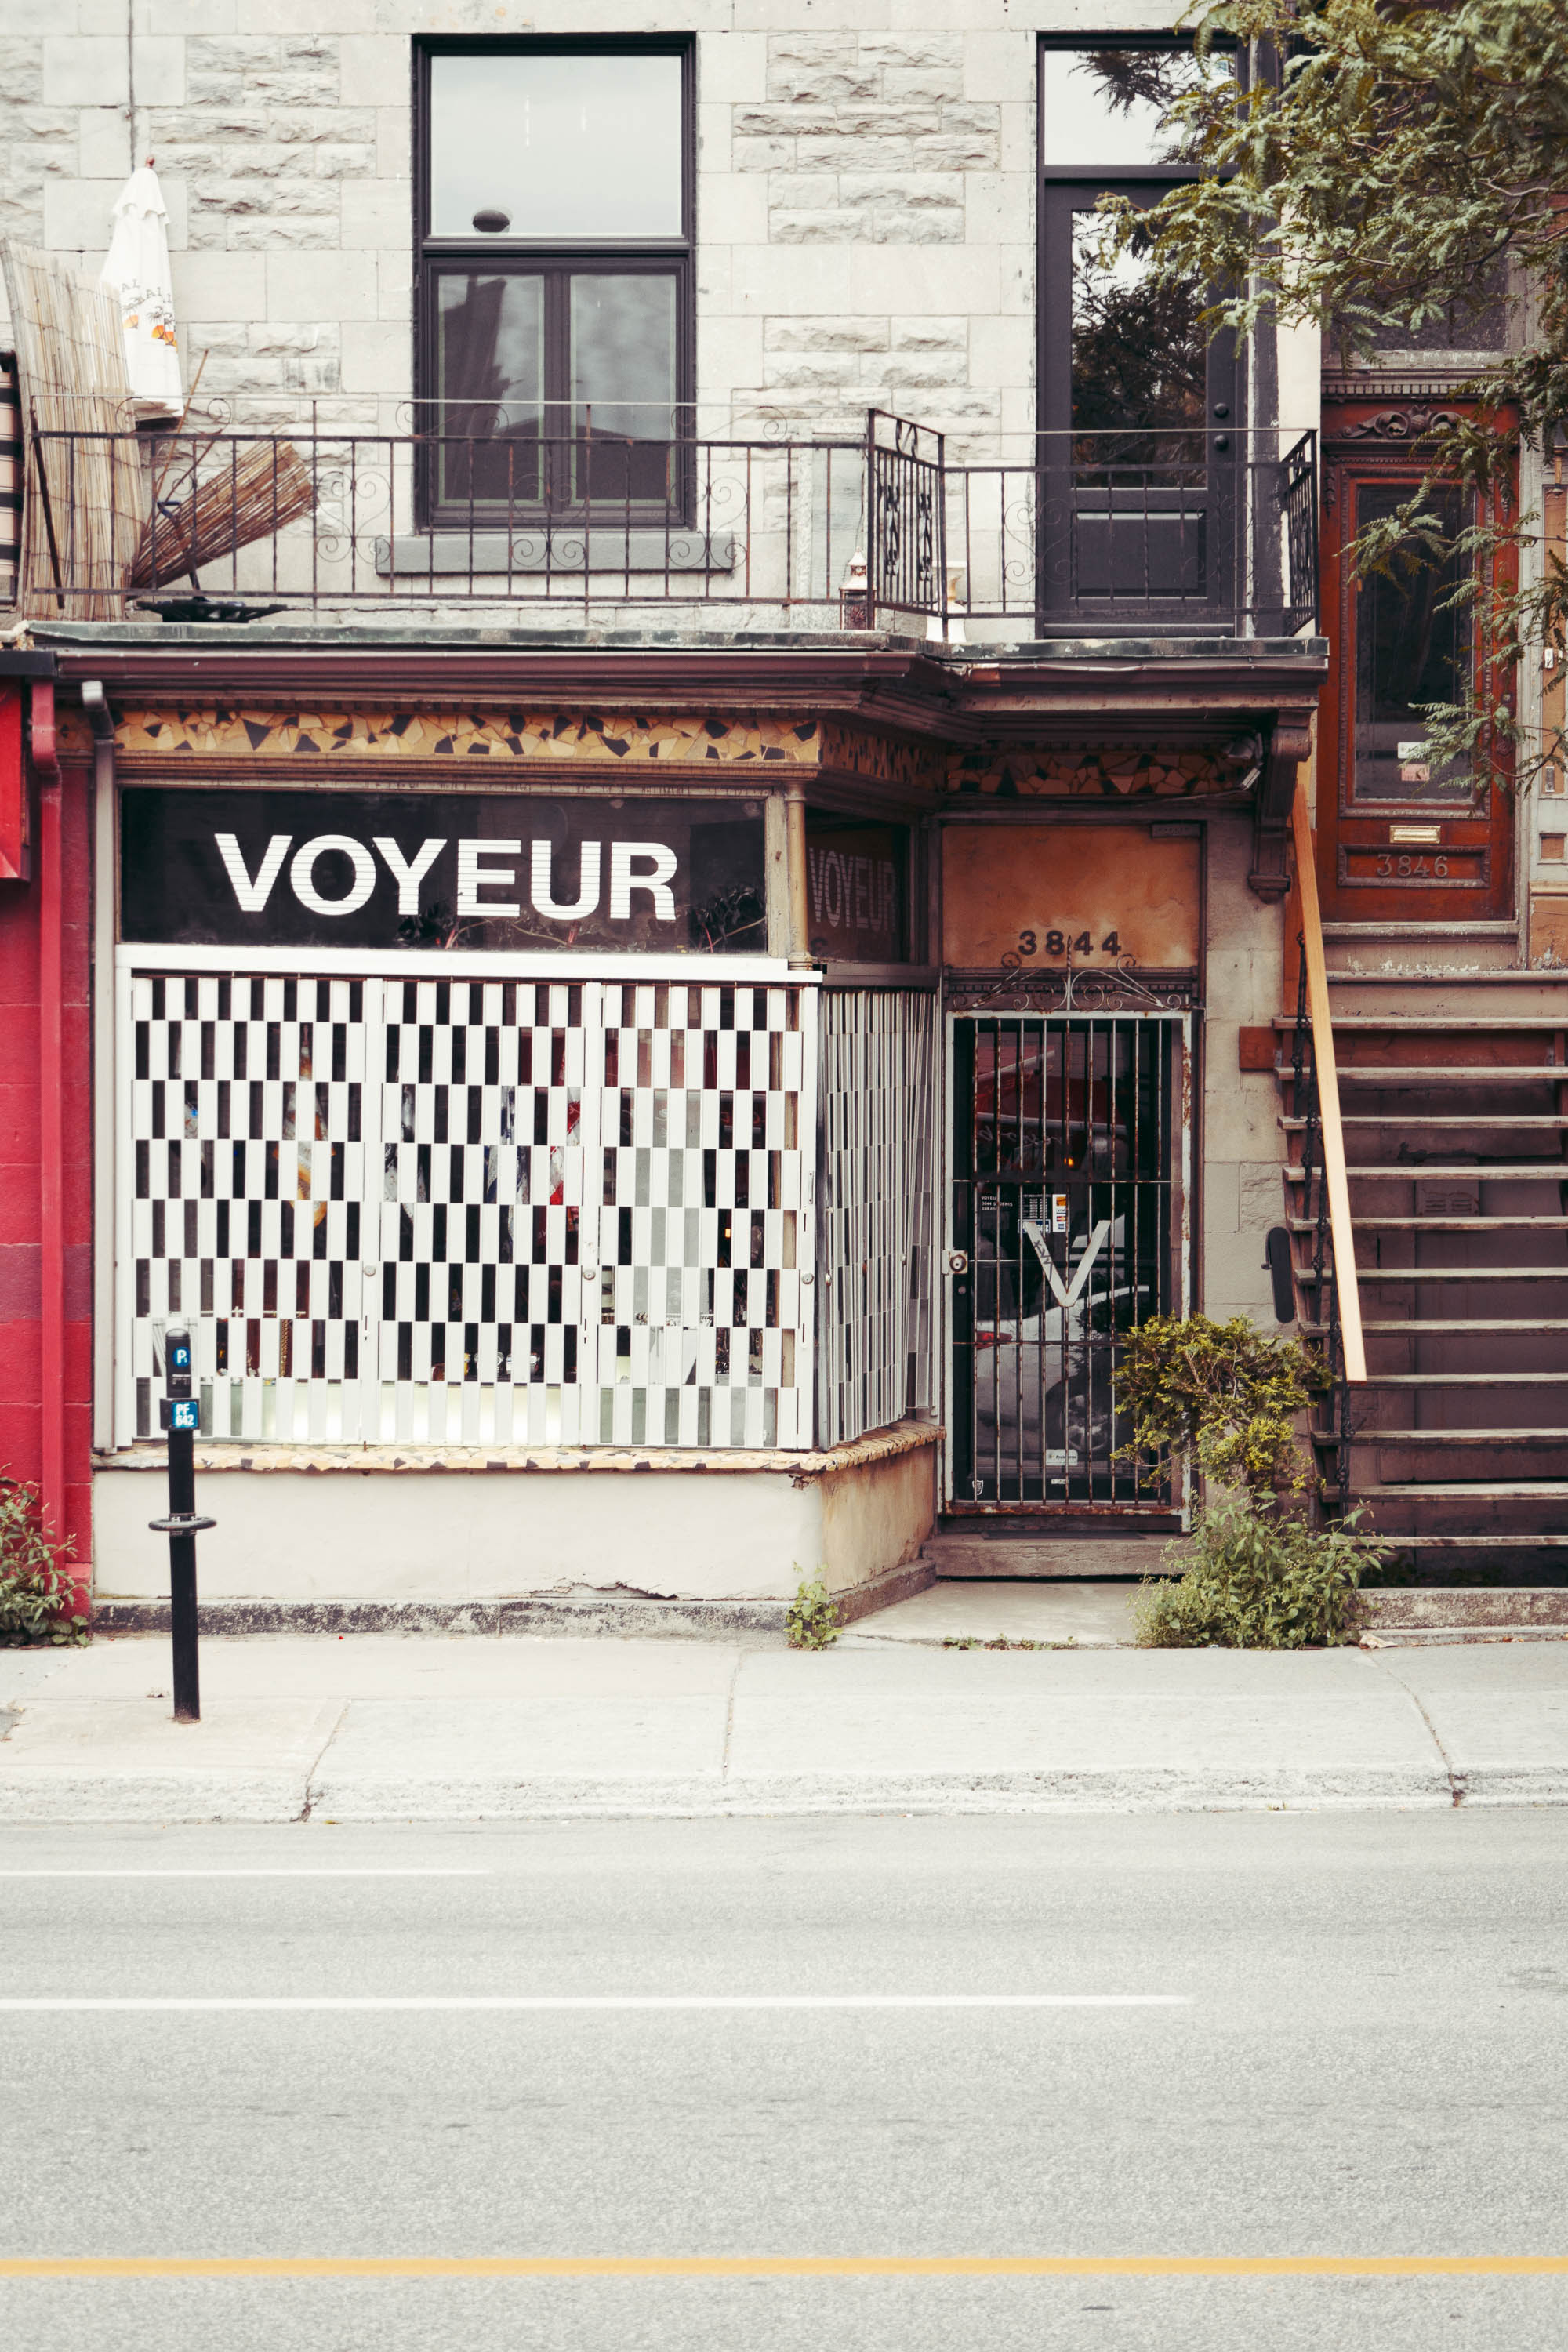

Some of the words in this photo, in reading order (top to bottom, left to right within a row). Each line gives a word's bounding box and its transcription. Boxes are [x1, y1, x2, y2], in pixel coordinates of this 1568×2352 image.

[214, 833, 678, 920] VOYEUR
[1377, 854, 1449, 878] 3846
[808, 847, 896, 932] VOYEUR
[1018, 930, 1121, 956] 3844
[175, 1403, 190, 1415] PF
[176, 1414, 194, 1426] 642
